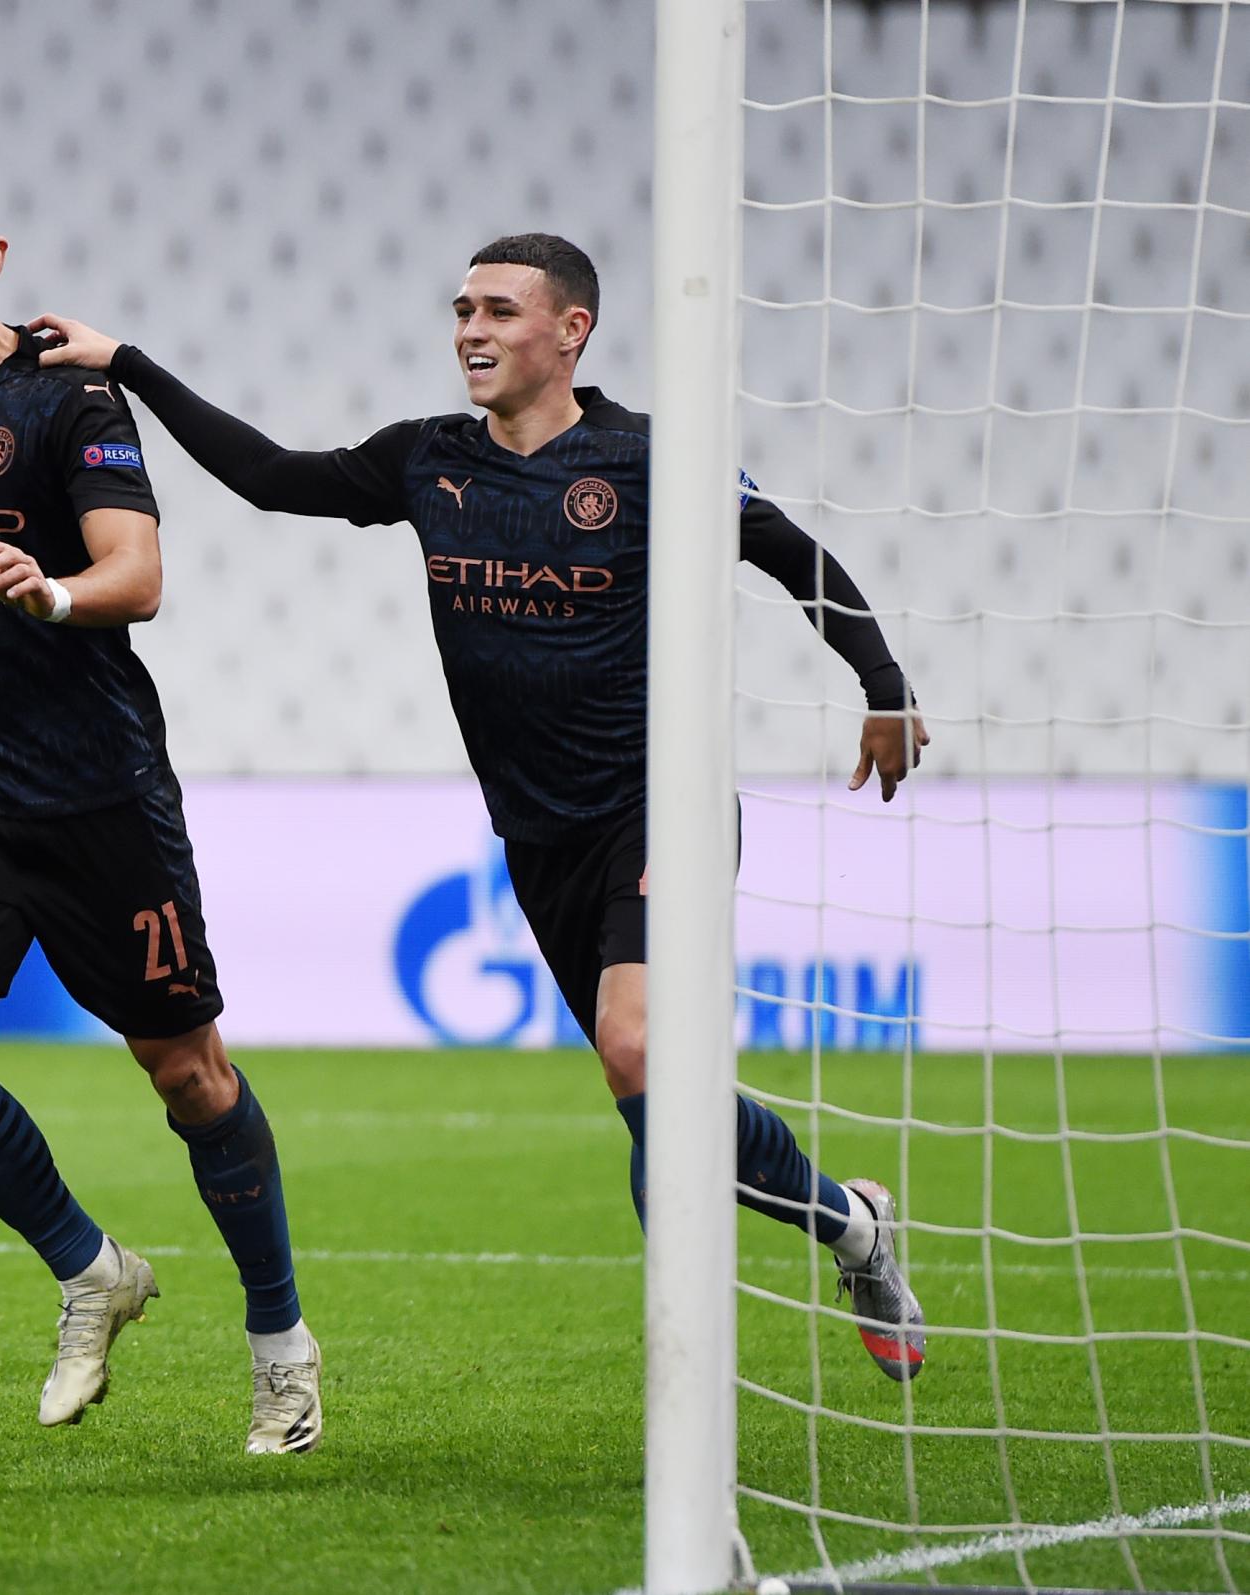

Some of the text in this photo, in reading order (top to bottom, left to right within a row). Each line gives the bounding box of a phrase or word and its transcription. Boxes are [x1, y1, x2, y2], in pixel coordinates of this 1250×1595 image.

[104, 449, 141, 464] RESPEC
[427, 555, 613, 592] ETIHAD
[452, 594, 575, 617] AIRWAYS
[133, 900, 188, 981] 21
